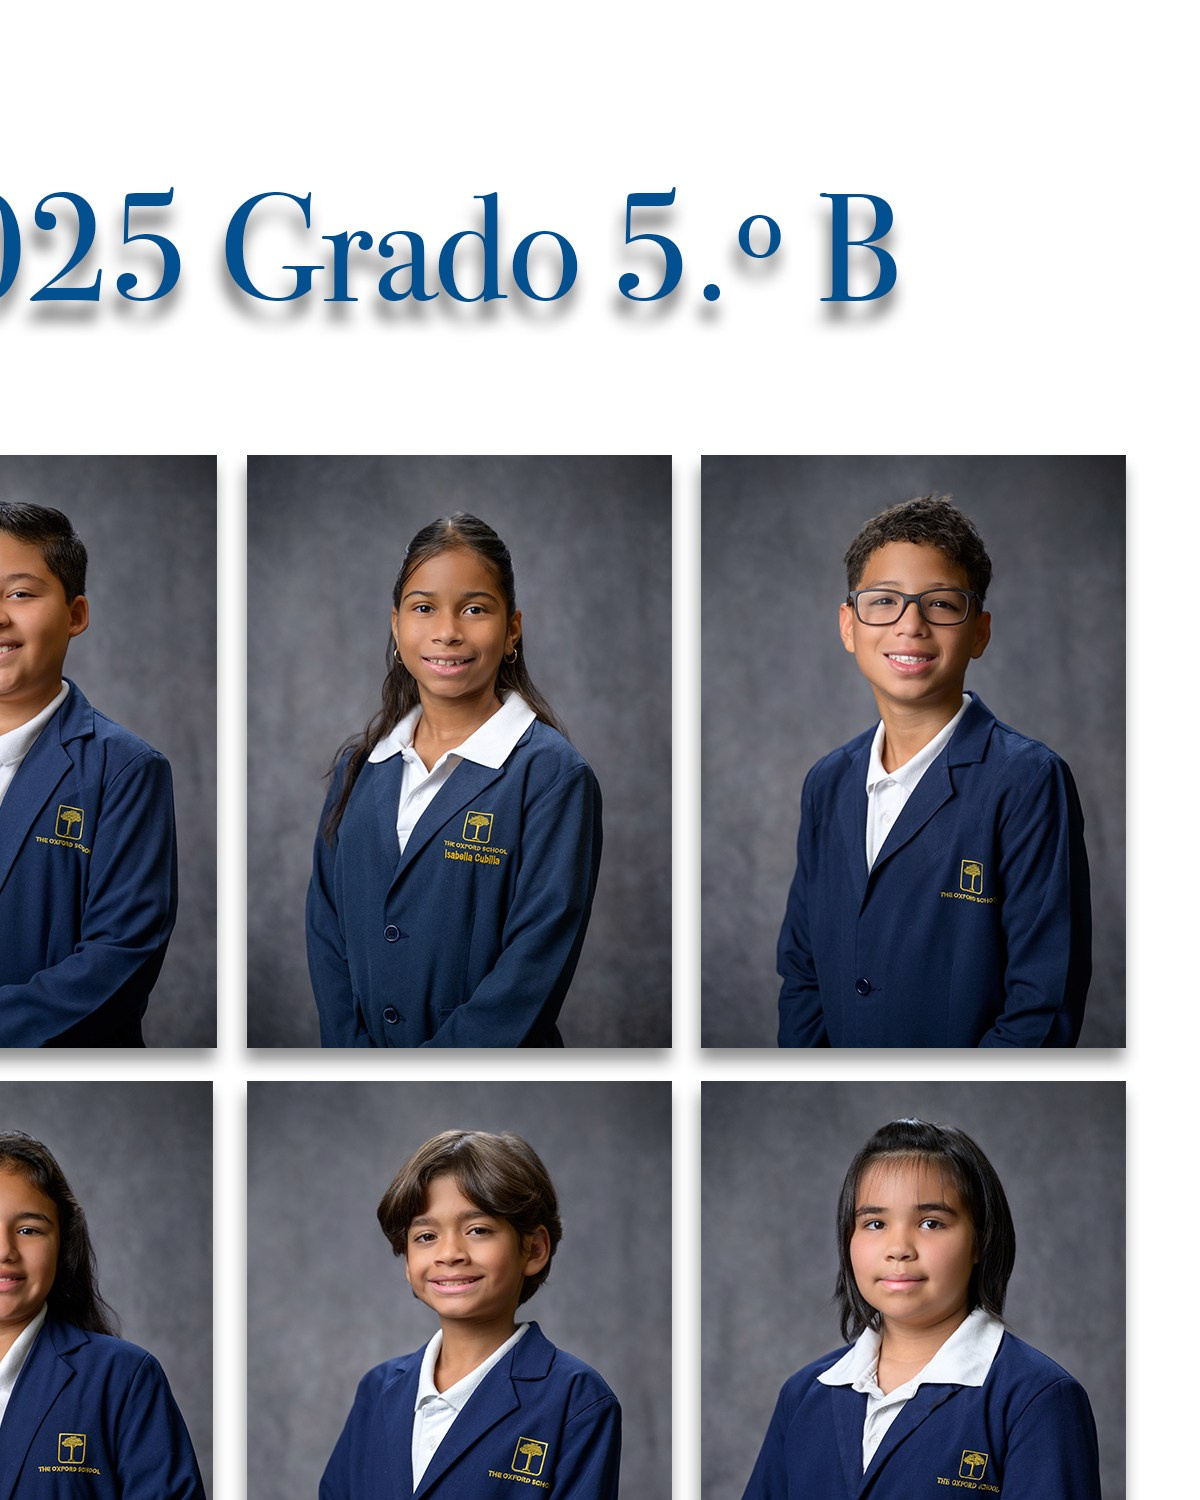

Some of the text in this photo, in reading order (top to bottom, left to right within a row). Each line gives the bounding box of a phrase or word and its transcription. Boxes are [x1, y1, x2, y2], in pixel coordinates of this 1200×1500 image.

[36, 836, 48, 844] THE
[49, 839, 73, 848] OXFORD
[444, 840, 507, 856] THE OXFORD SCHOOL
[444, 849, 500, 866] Isabella Cubilla
[954, 892, 975, 902] OXFORD
[78, 1467, 101, 1476] SCHOOL
[488, 1470, 502, 1480] THE
[503, 1473, 530, 1484] OXFORD
[937, 1477, 1000, 1493] THE OXFORD SCHOOL
